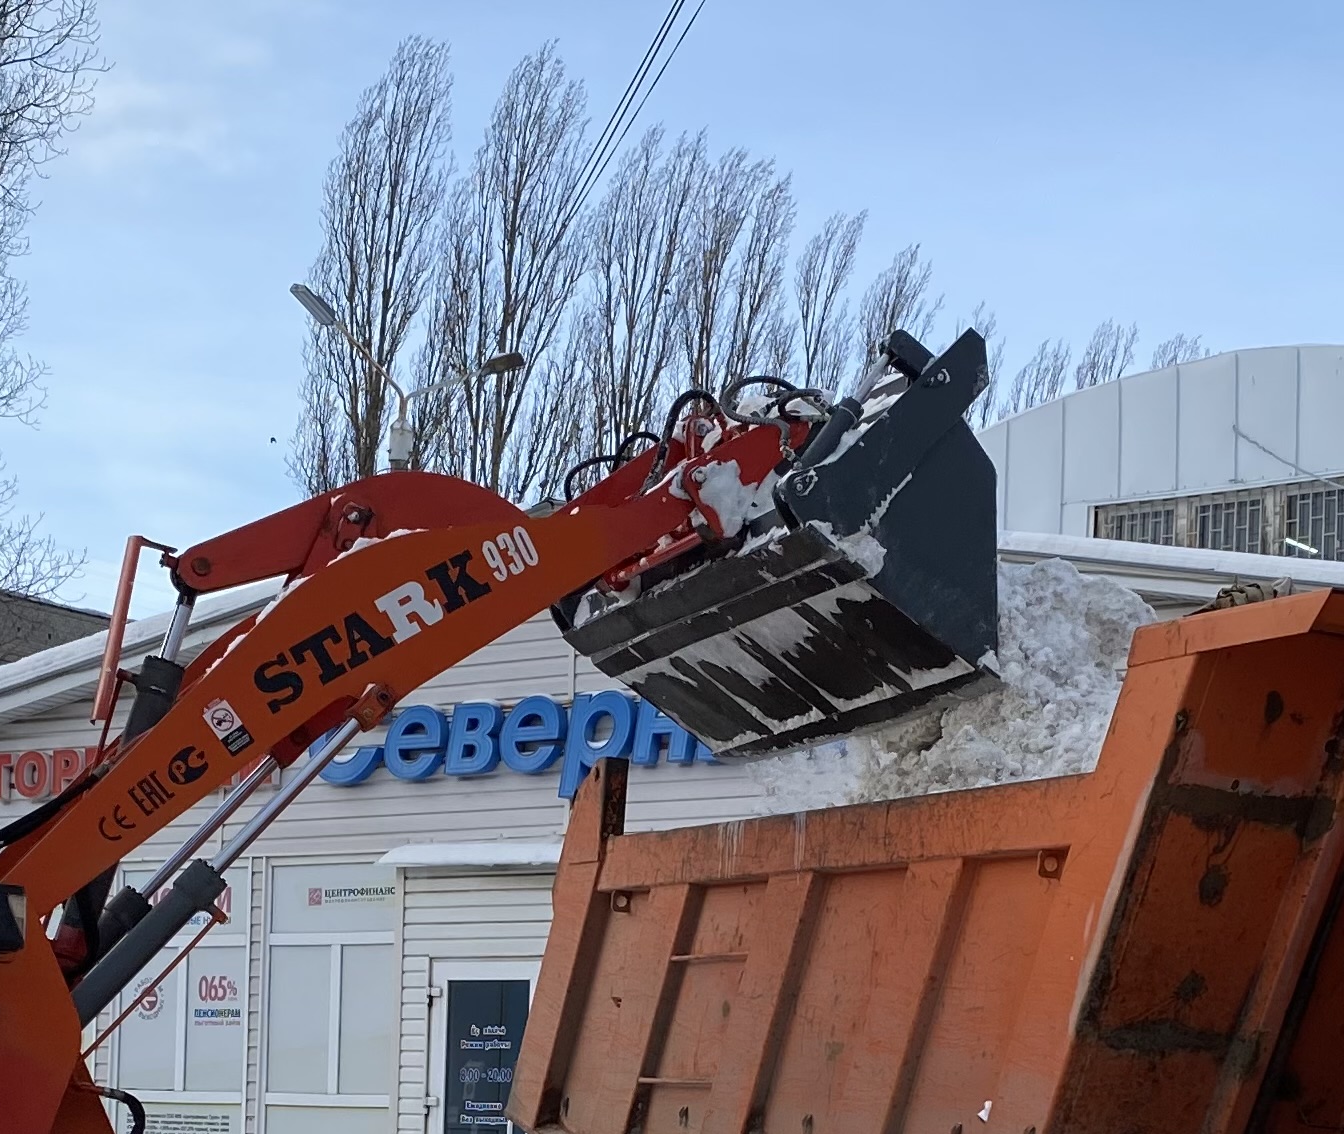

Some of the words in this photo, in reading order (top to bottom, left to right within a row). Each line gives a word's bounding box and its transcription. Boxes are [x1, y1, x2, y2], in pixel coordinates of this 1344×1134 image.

[254, 550, 492, 713] STARK
[481, 526, 540, 582] 930
[324, 886, 396, 899] ЦЕНТРОФИНАНС
